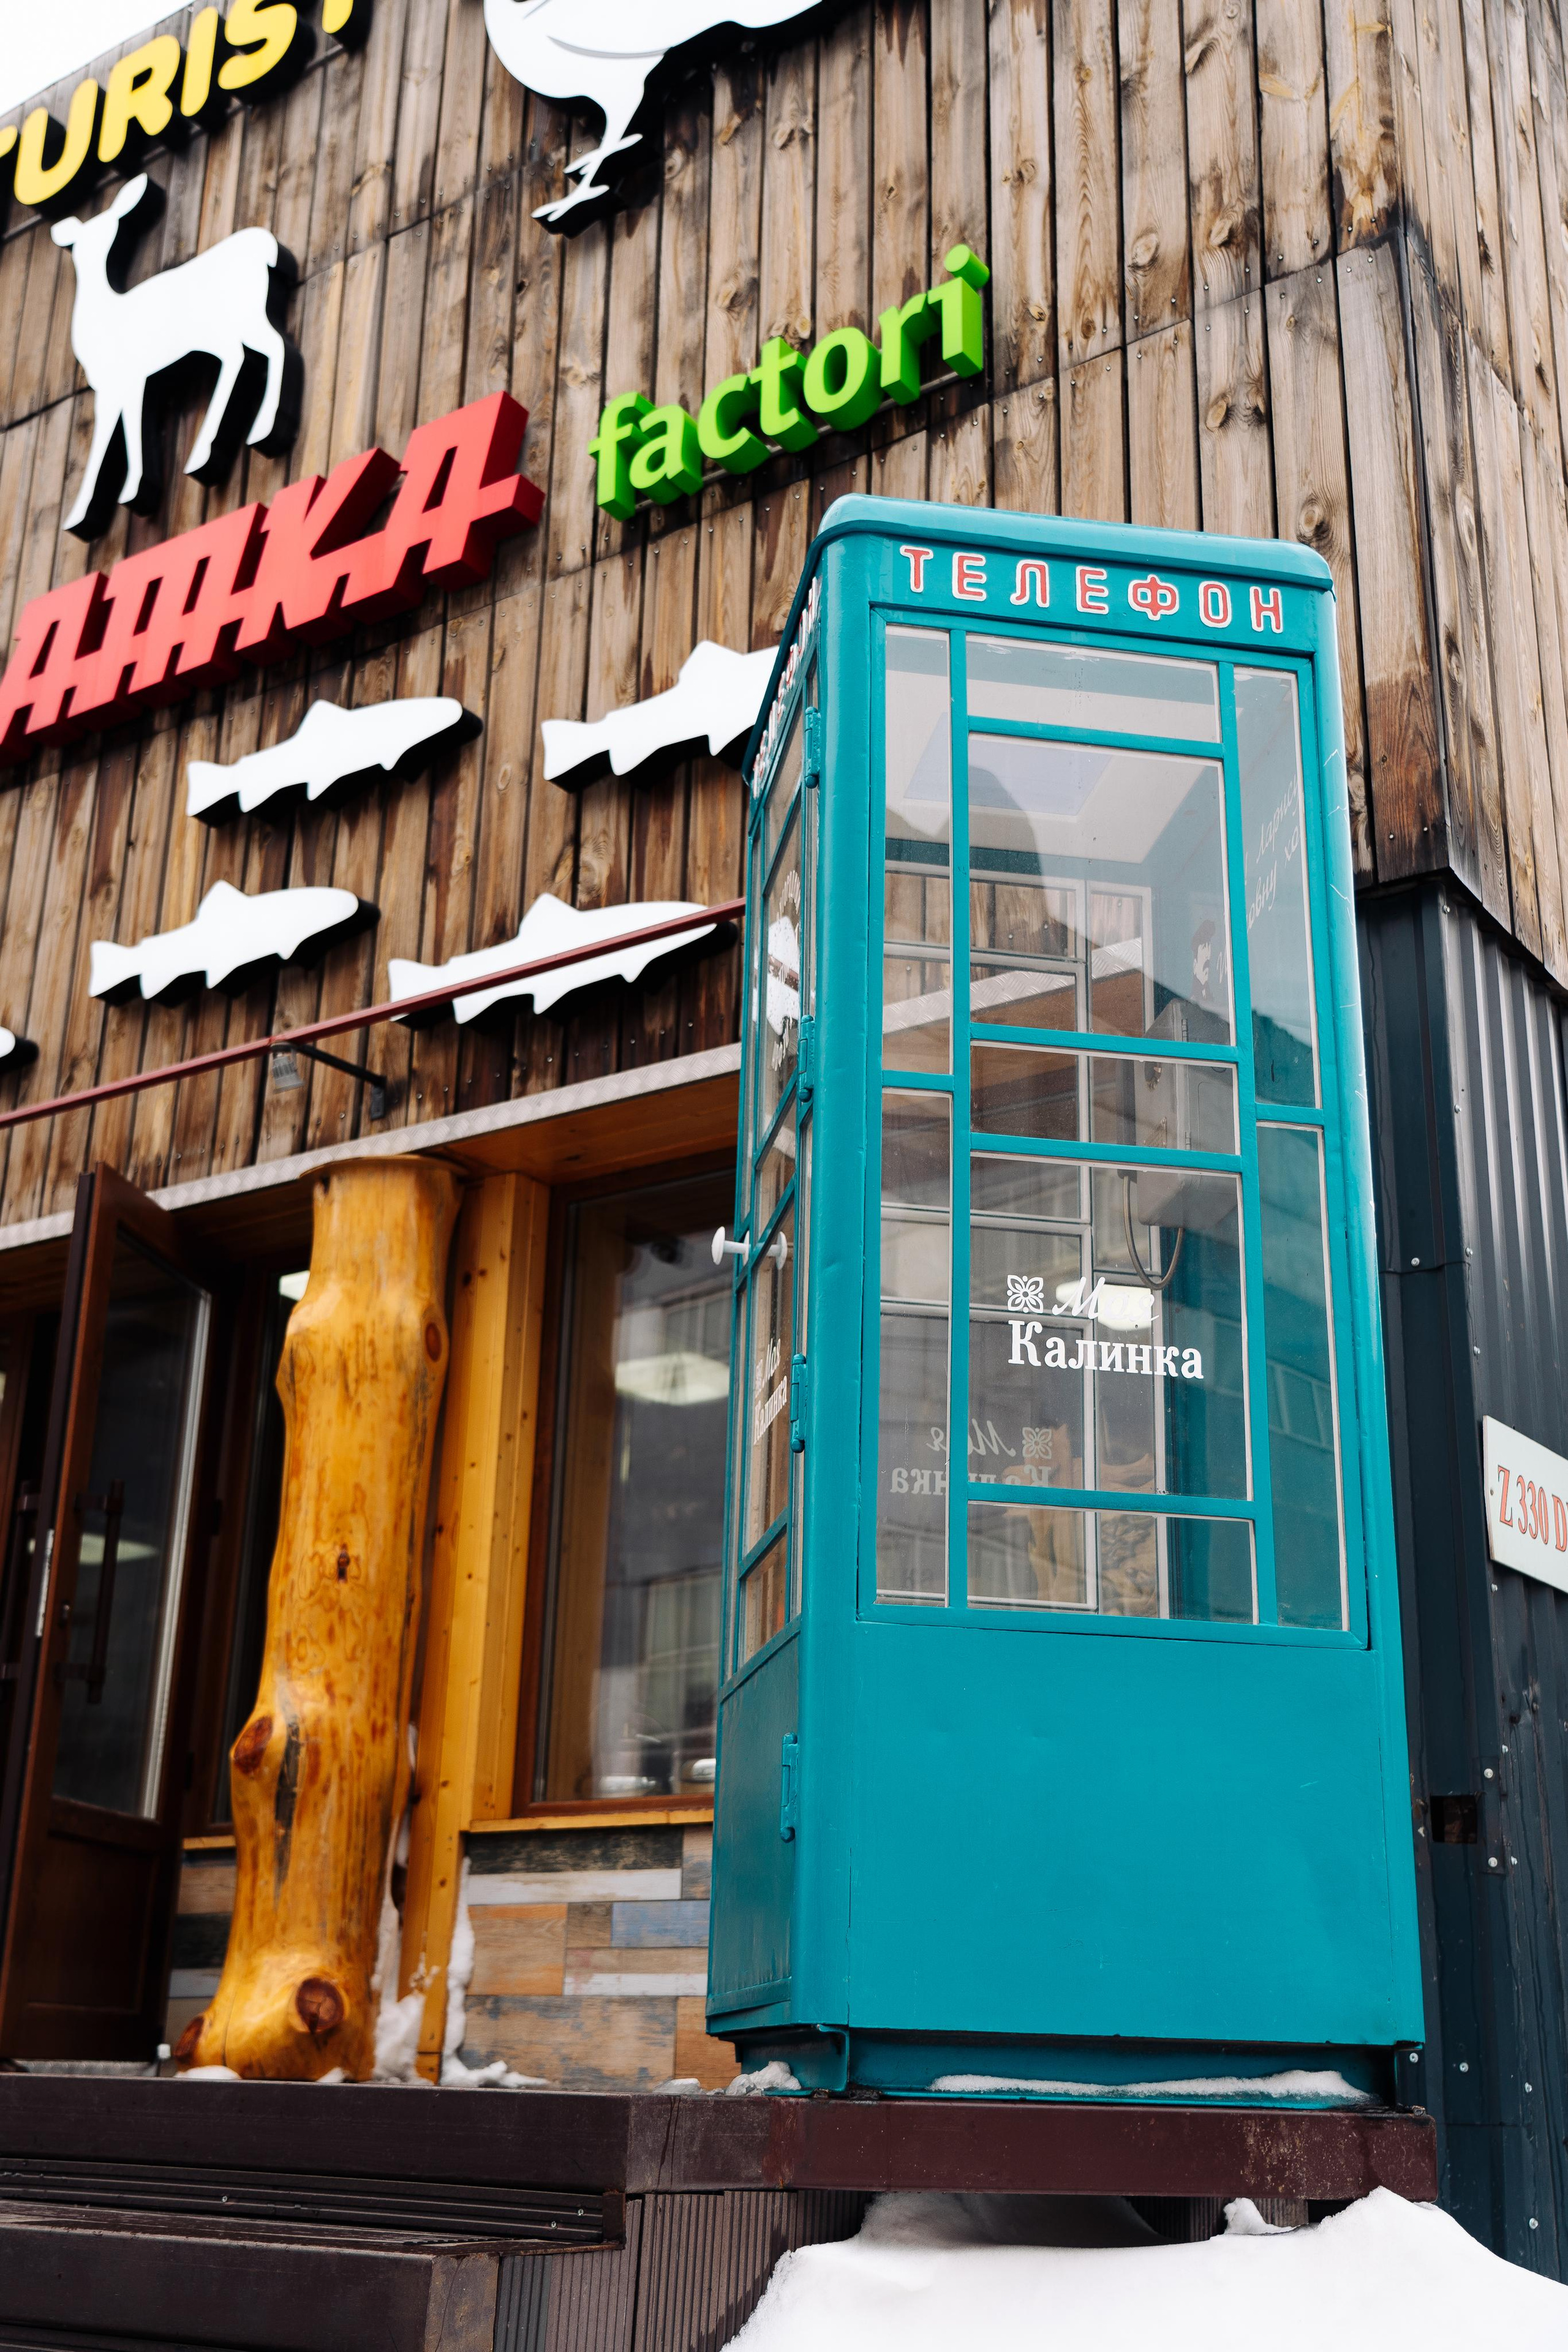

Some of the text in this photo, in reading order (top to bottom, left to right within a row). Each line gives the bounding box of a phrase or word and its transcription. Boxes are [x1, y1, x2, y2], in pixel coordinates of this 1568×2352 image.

[0, 0, 355, 206] URIS
[588, 244, 983, 516] factori
[900, 545, 1284, 634] ТЕЛЕФОН
[1008, 1319, 1204, 1379] Калинка
[1498, 1464, 1568, 1552] Z 330 D
